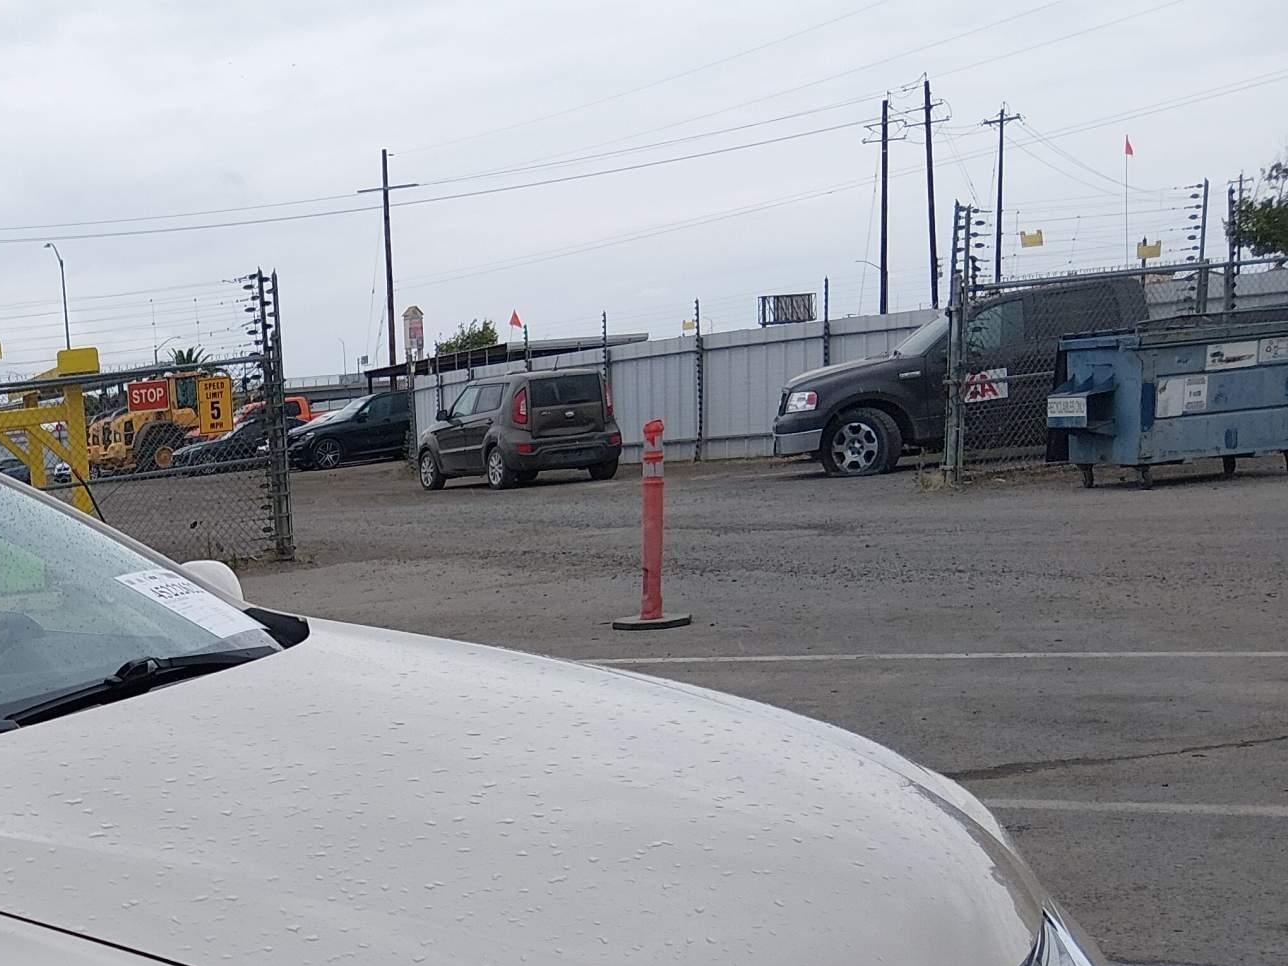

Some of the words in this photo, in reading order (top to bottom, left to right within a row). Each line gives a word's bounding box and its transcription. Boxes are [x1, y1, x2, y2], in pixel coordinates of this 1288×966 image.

[204, 381, 225, 390] SPEED
[132, 387, 164, 404] STOP
[206, 391, 223, 399] LIMIT
[210, 401, 221, 420] 5
[210, 422, 224, 430] MPH
